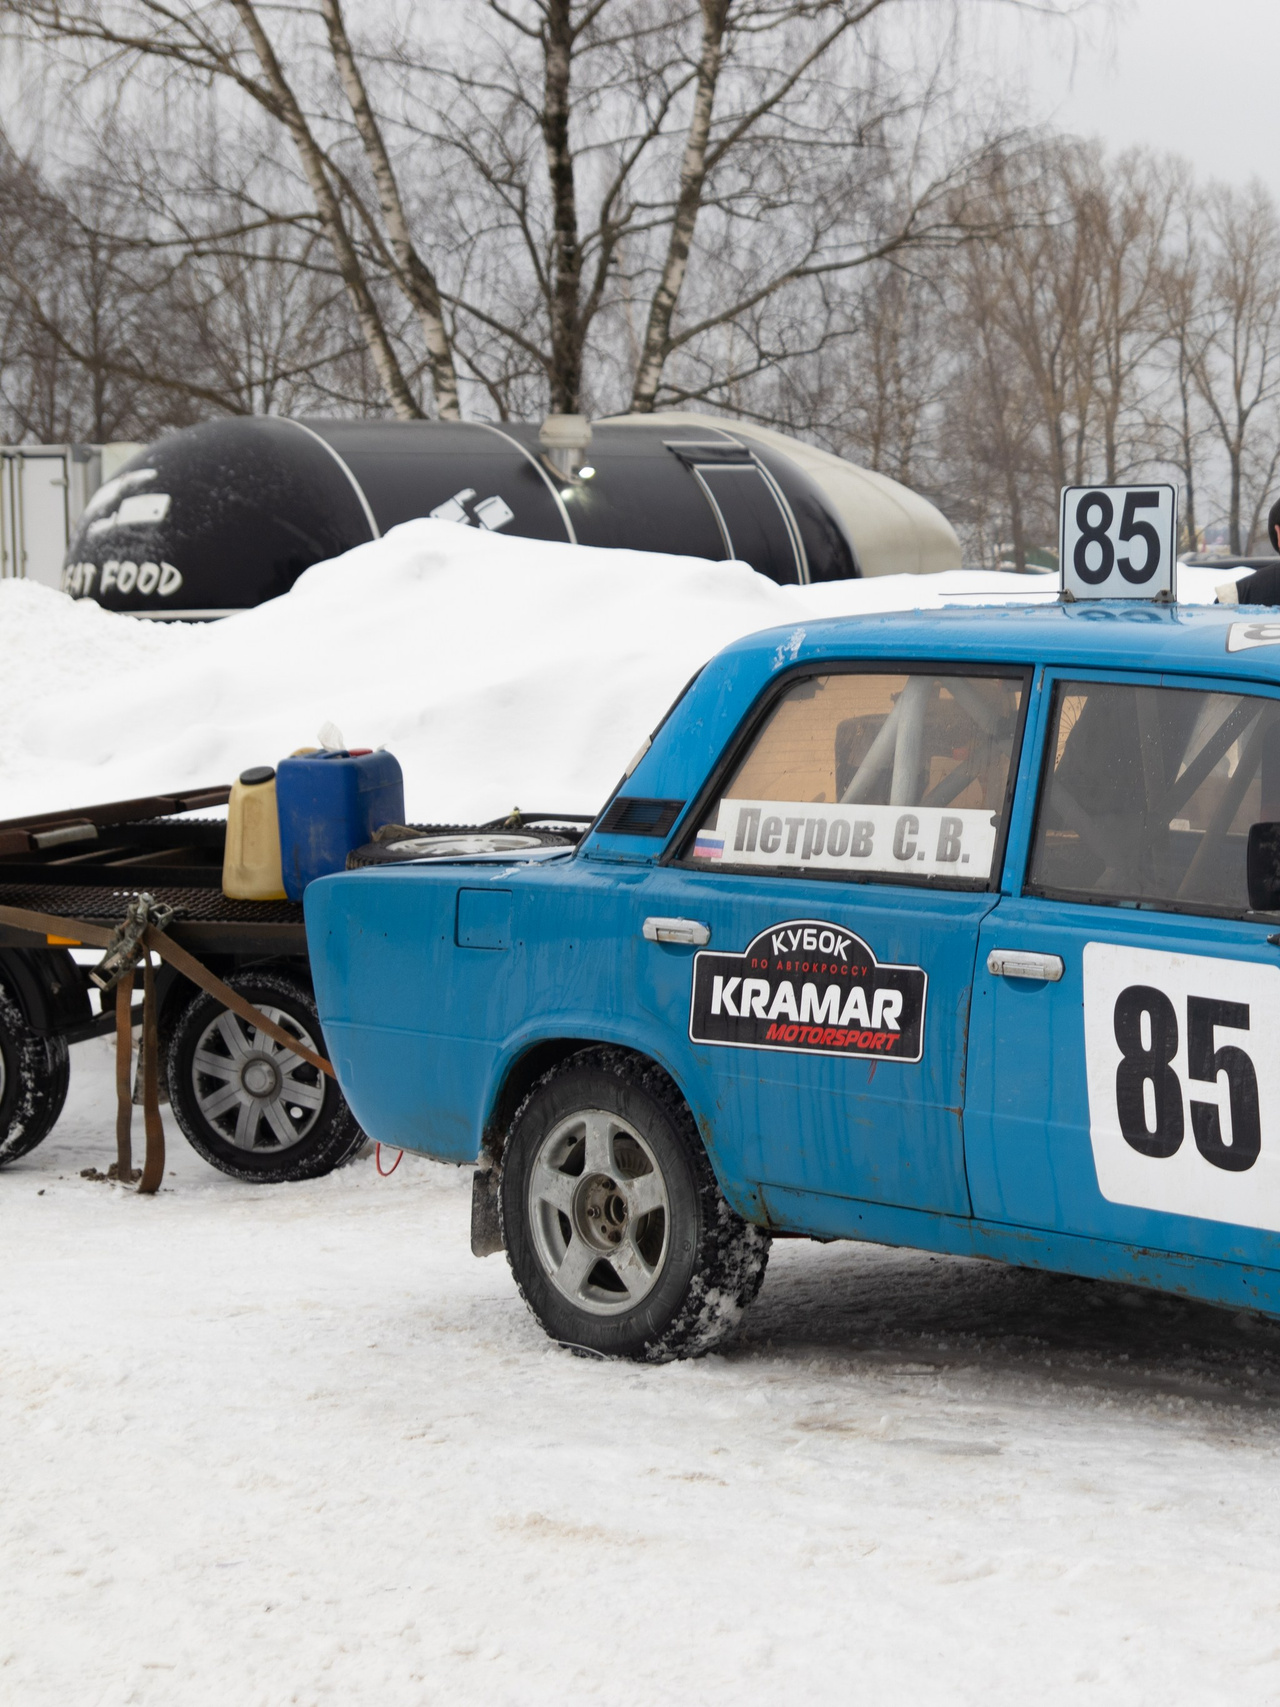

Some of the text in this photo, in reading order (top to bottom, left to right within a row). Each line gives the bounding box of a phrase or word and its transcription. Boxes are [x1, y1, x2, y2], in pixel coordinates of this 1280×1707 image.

[1073, 491, 1161, 585] 85
[100, 560, 183, 596] FOOD
[733, 807, 970, 863] Петров С. В.
[771, 928, 852, 961] КУБОК
[751, 959, 868, 977] ПО АВТОКРОССУ
[711, 975, 903, 1030] KRAMAR
[765, 1023, 900, 1051] MOTORSPORT
[1112, 984, 1262, 1173] 85
